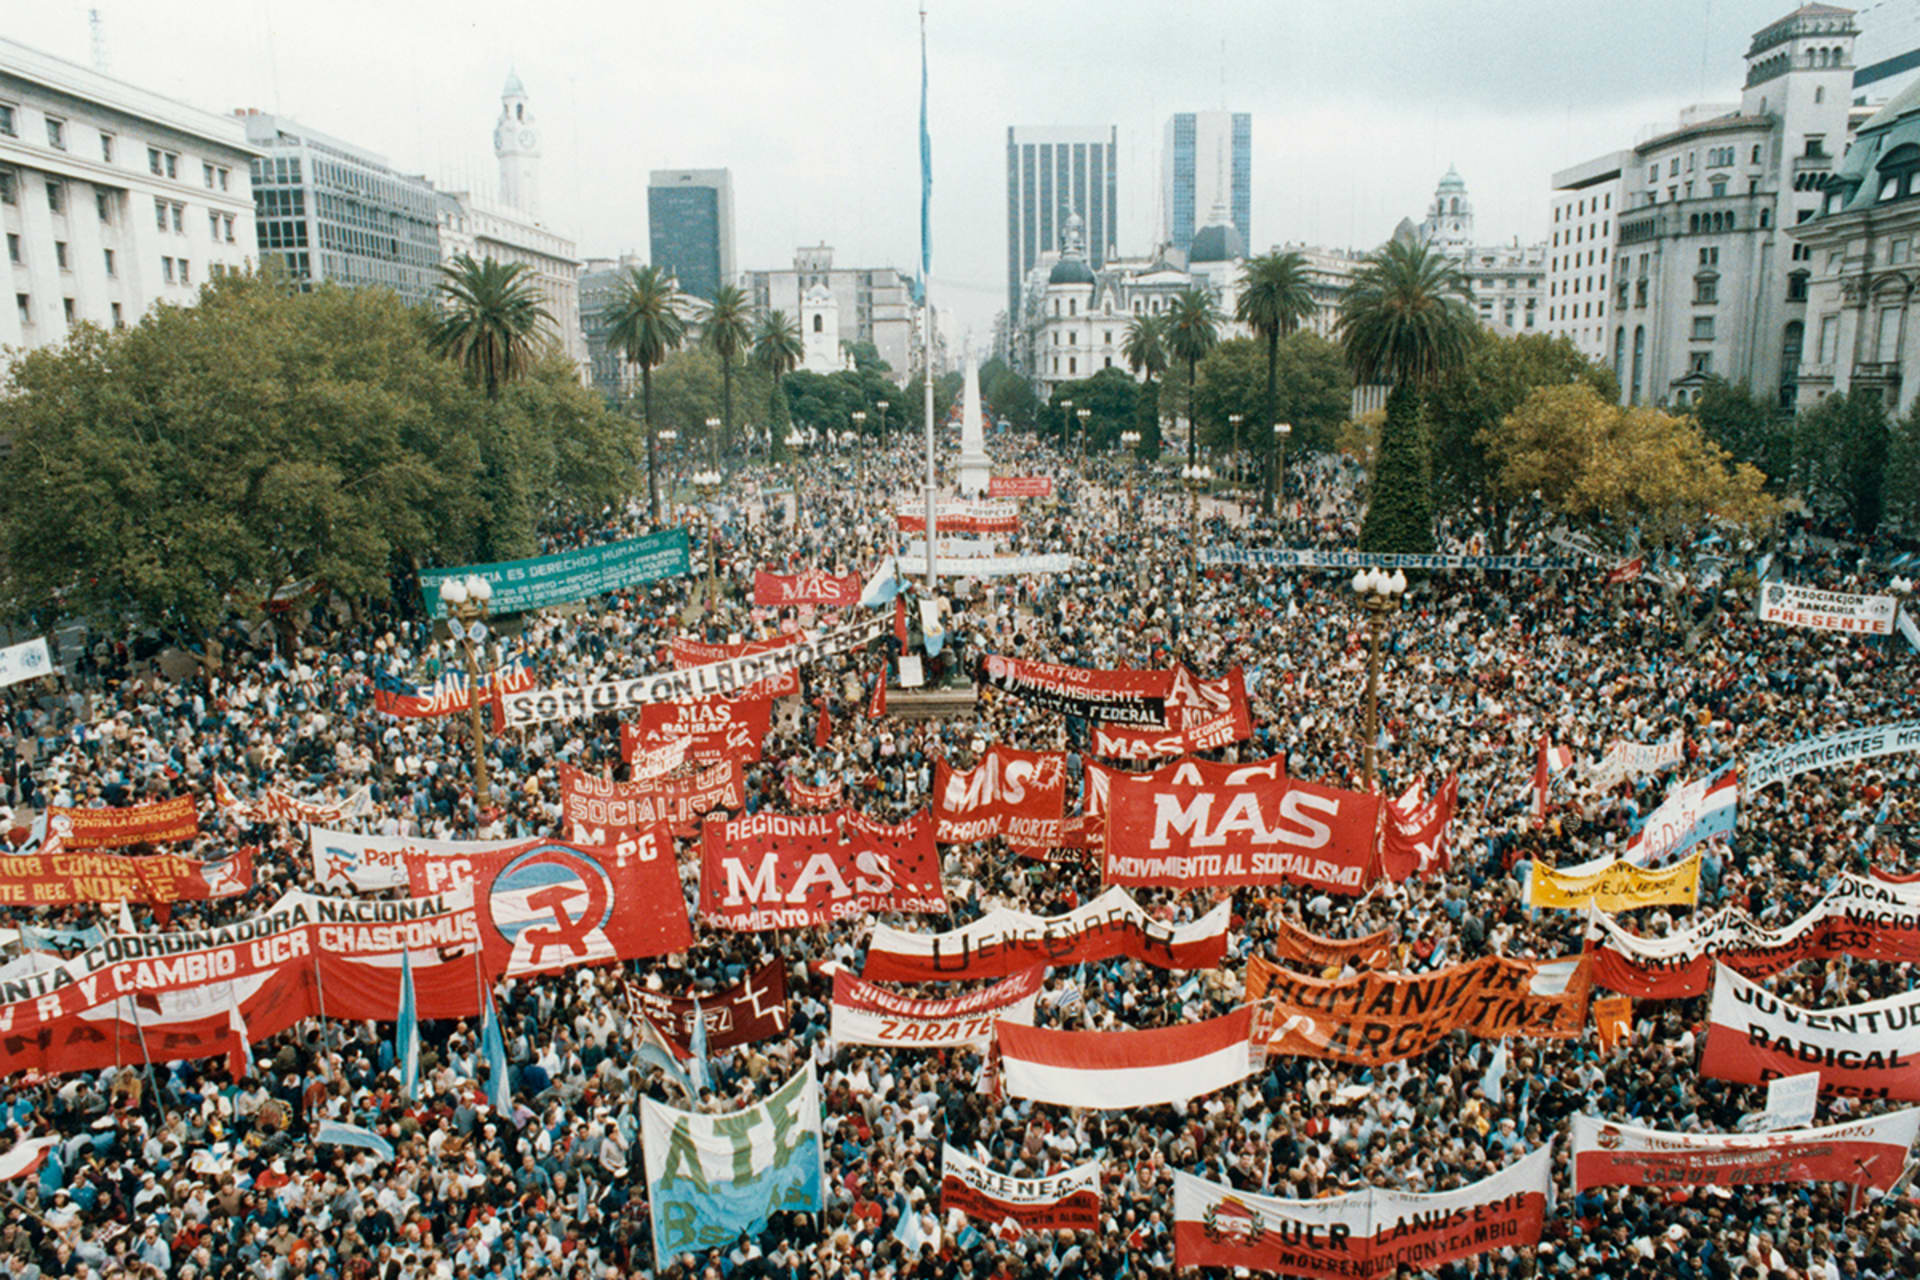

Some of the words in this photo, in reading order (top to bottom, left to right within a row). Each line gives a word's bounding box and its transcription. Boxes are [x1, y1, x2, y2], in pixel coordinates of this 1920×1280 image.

[507, 567, 526, 581] ES
[528, 553, 599, 578] DERECHOS
[781, 580, 841, 601] MAS
[1767, 608, 1887, 633] PRESENTE
[625, 671, 694, 705] CON
[1019, 675, 1145, 703] INTRANSIGENTE
[1024, 661, 1091, 683] PARTIDO
[677, 704, 732, 723] MAS
[1090, 705, 1162, 724] FEDERAL
[1095, 730, 1185, 759] MAS
[942, 752, 1035, 815] MAS
[568, 783, 738, 827] SOCIALISTA
[1149, 789, 1340, 850] MAS
[725, 816, 832, 842] REGIONAL
[1008, 816, 1061, 838] NORTE
[52, 854, 190, 878] COMUNSTA
[615, 833, 659, 868] PC
[425, 859, 474, 893] PC
[720, 851, 896, 907] MAS
[1107, 853, 1222, 879] MOVIMIENTO
[1224, 853, 1247, 876] AL
[1250, 852, 1363, 888] SOCIALISMO
[700, 909, 810, 931] MOVIMIENTO
[811, 911, 826, 924] AL
[831, 896, 948, 922] SOCIALISMO
[84, 902, 310, 972] COORDINADORA
[317, 895, 453, 923] NACIONAL
[111, 949, 236, 993] CAMBIO
[250, 929, 311, 968] UCR
[318, 910, 478, 953] CHASCOMUS
[850, 981, 954, 1017] JUVENTUD
[878, 1013, 1001, 1042] ZARATE
[1325, 994, 1564, 1059] ARGETINA
[1747, 1022, 1911, 1071] RADICAL
[1728, 1161, 1793, 1183] OESTE
[1280, 1219, 1351, 1253] UCR
[1375, 1206, 1470, 1247] LANUS
[1473, 1190, 1527, 1223] ESTE
[1449, 1218, 1518, 1252] CAMBIO
